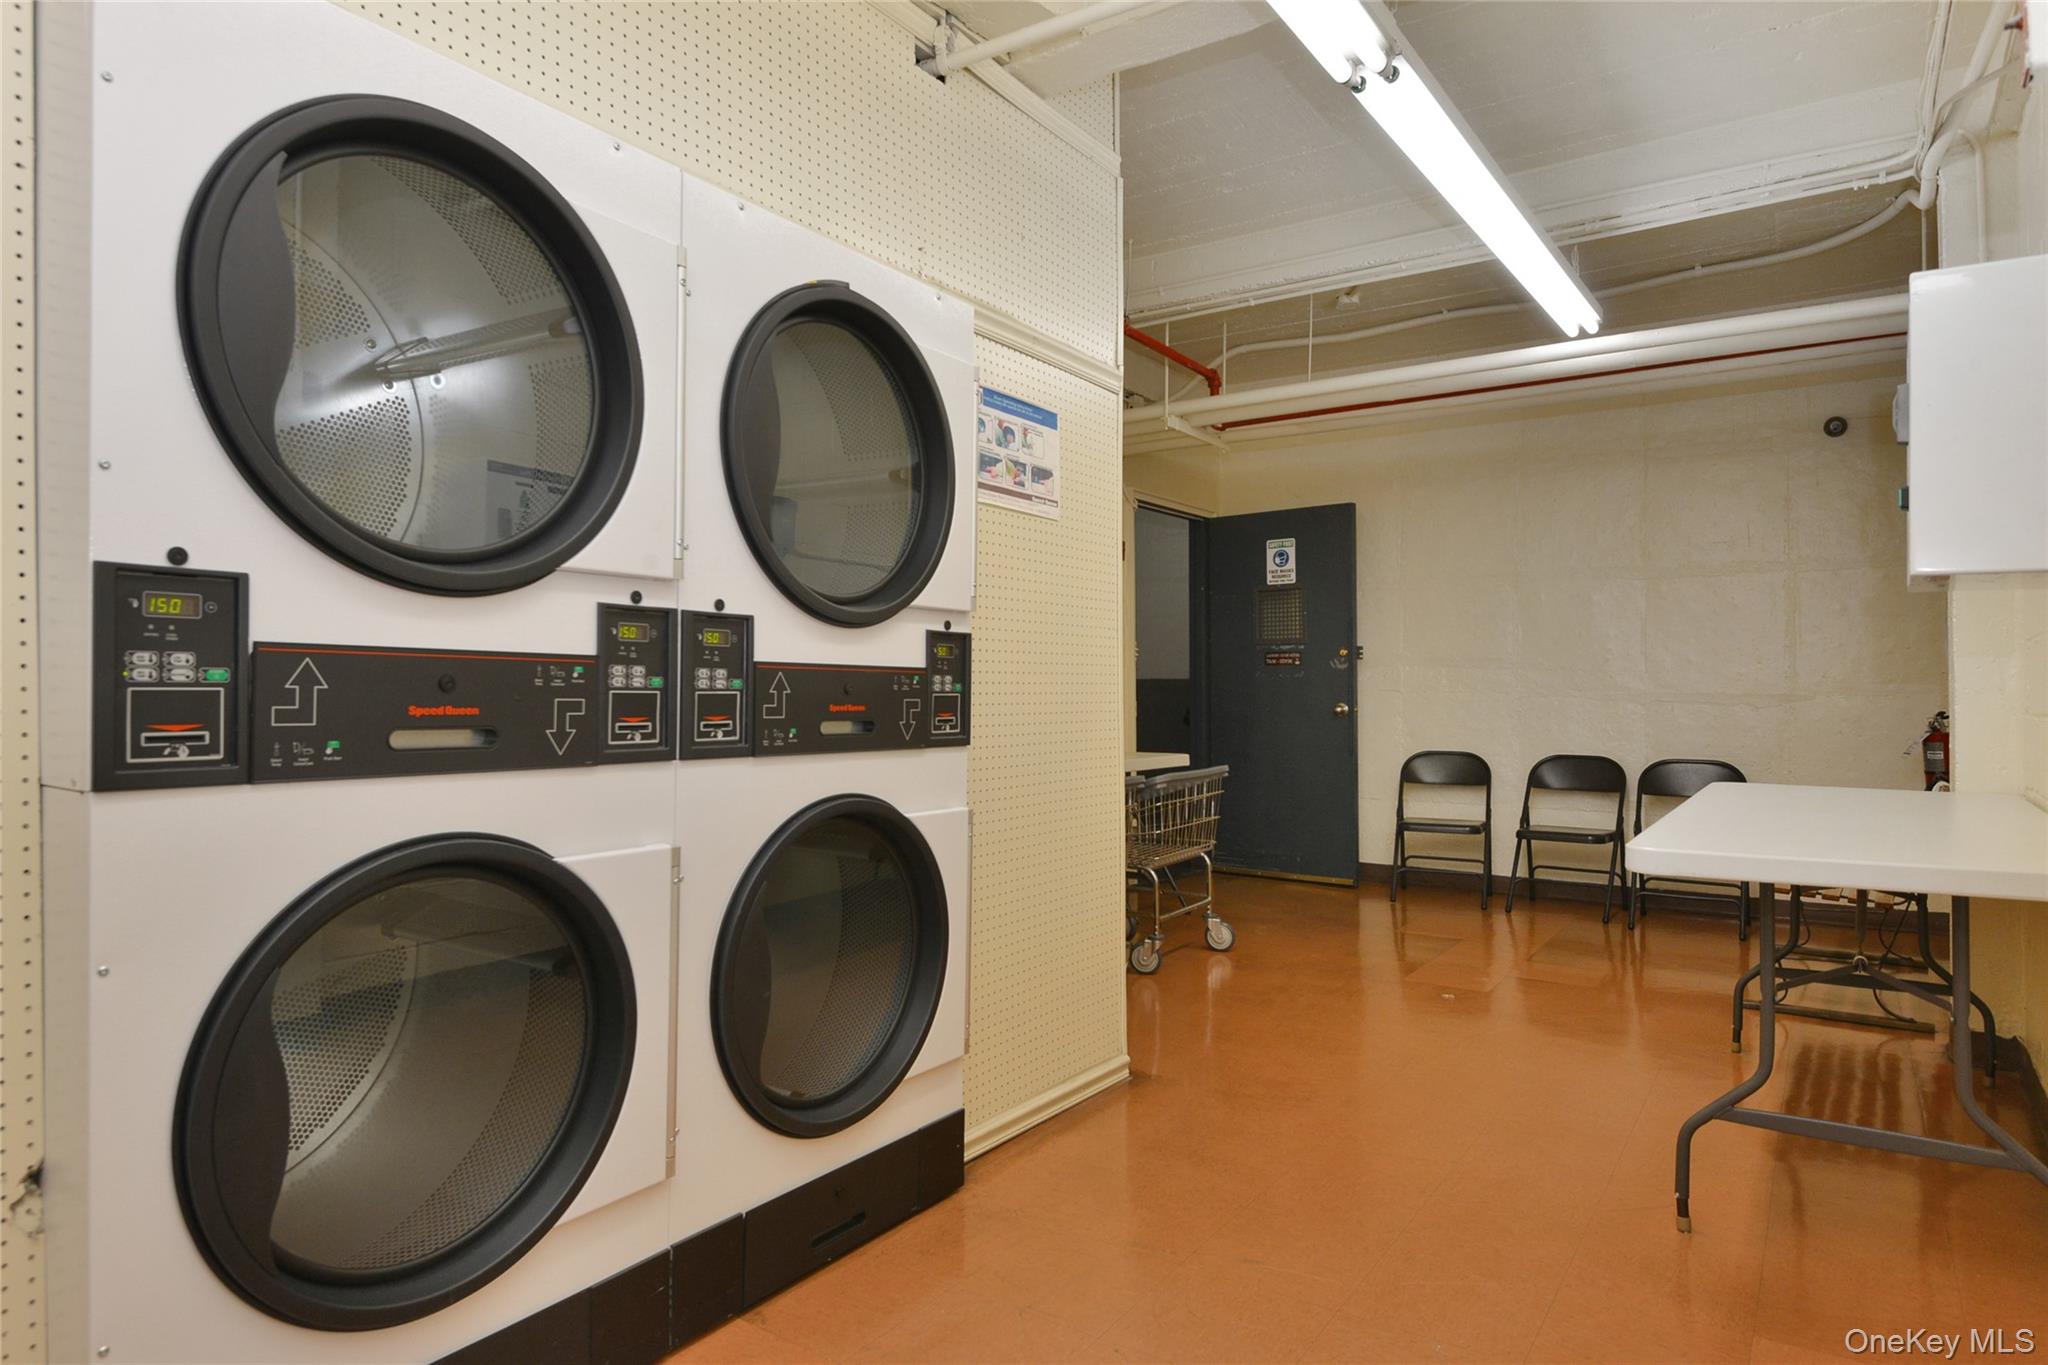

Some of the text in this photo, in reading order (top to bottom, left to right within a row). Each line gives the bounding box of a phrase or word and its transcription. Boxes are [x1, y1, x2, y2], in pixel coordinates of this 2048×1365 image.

[149, 598, 182, 614] 150
[408, 705, 480, 717] Speed Queen
[829, 704, 866, 712] Speed Queen
